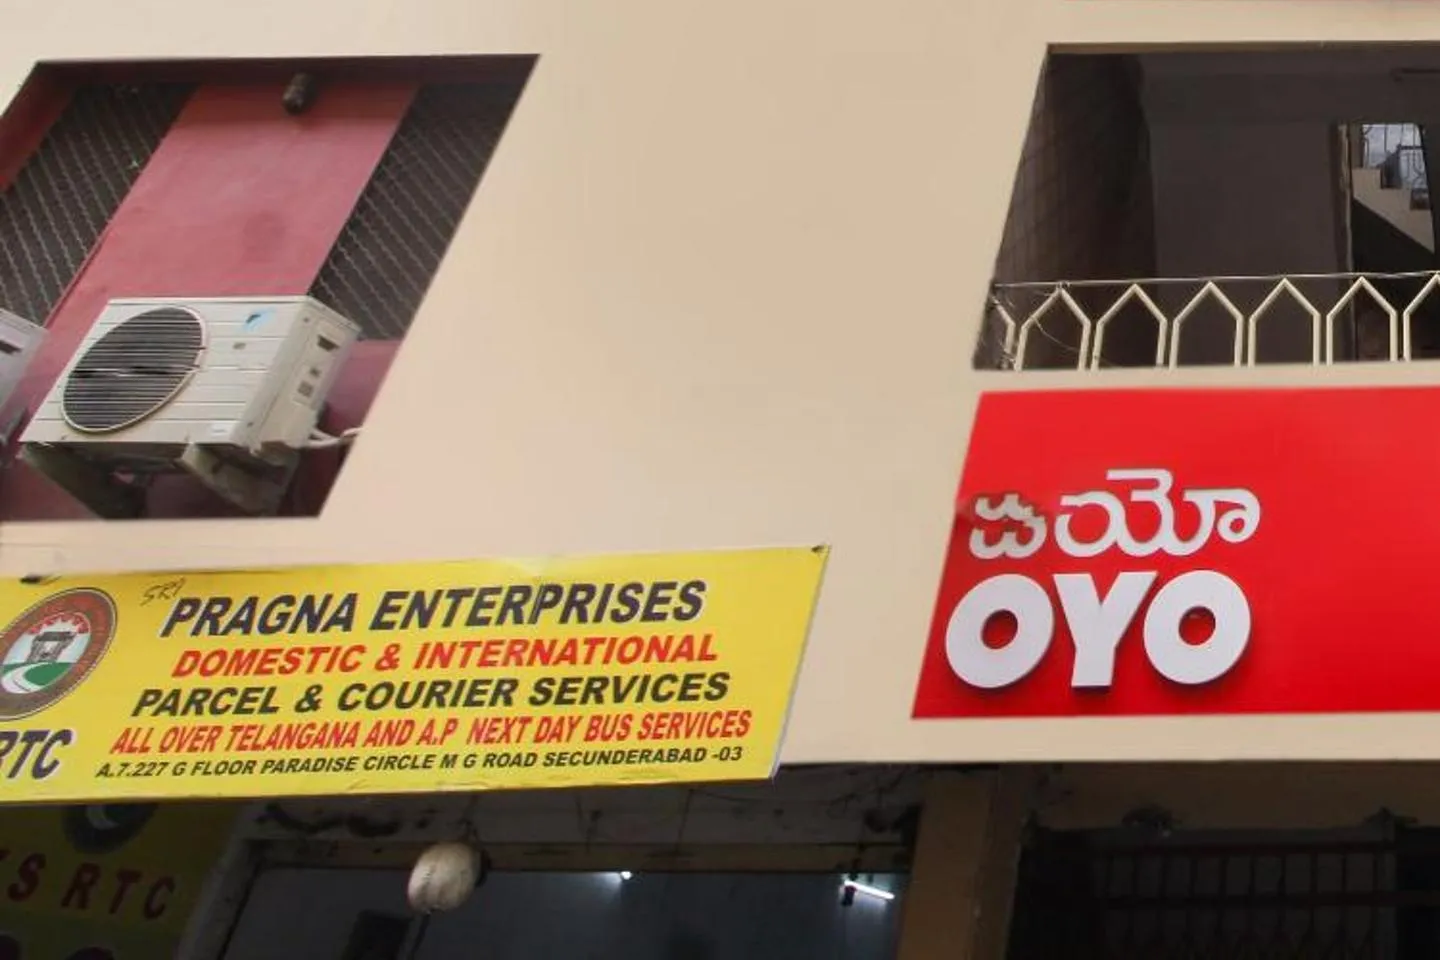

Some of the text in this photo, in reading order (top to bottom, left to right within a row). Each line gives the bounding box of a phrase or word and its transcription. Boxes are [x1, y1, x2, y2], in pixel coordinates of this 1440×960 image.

[160, 580, 706, 638] PRAGNA ENTERPRISES
[945, 569, 1251, 689] OYO
[171, 634, 718, 678] DOMESTIC & INTERNATIONAL
[131, 672, 730, 717] PARCEL & COURIER SERVICES
[110, 727, 152, 754] ALL
[158, 725, 223, 753] OVER
[224, 721, 361, 752] TELANGANA
[362, 719, 416, 748] AND
[467, 717, 532, 745] NEXT
[533, 715, 582, 744] DAY
[584, 713, 633, 742] BUS
[637, 710, 752, 740] SERVICES
[172, 763, 187, 777] G
[190, 760, 258, 776] FLOOR
[260, 757, 358, 774] PARADISE
[363, 754, 433, 771] CIRCLE
[439, 754, 458, 768] M
[463, 753, 477, 768] G
[483, 751, 537, 768] ROAD
[543, 748, 706, 766] SECUNDERABAD
